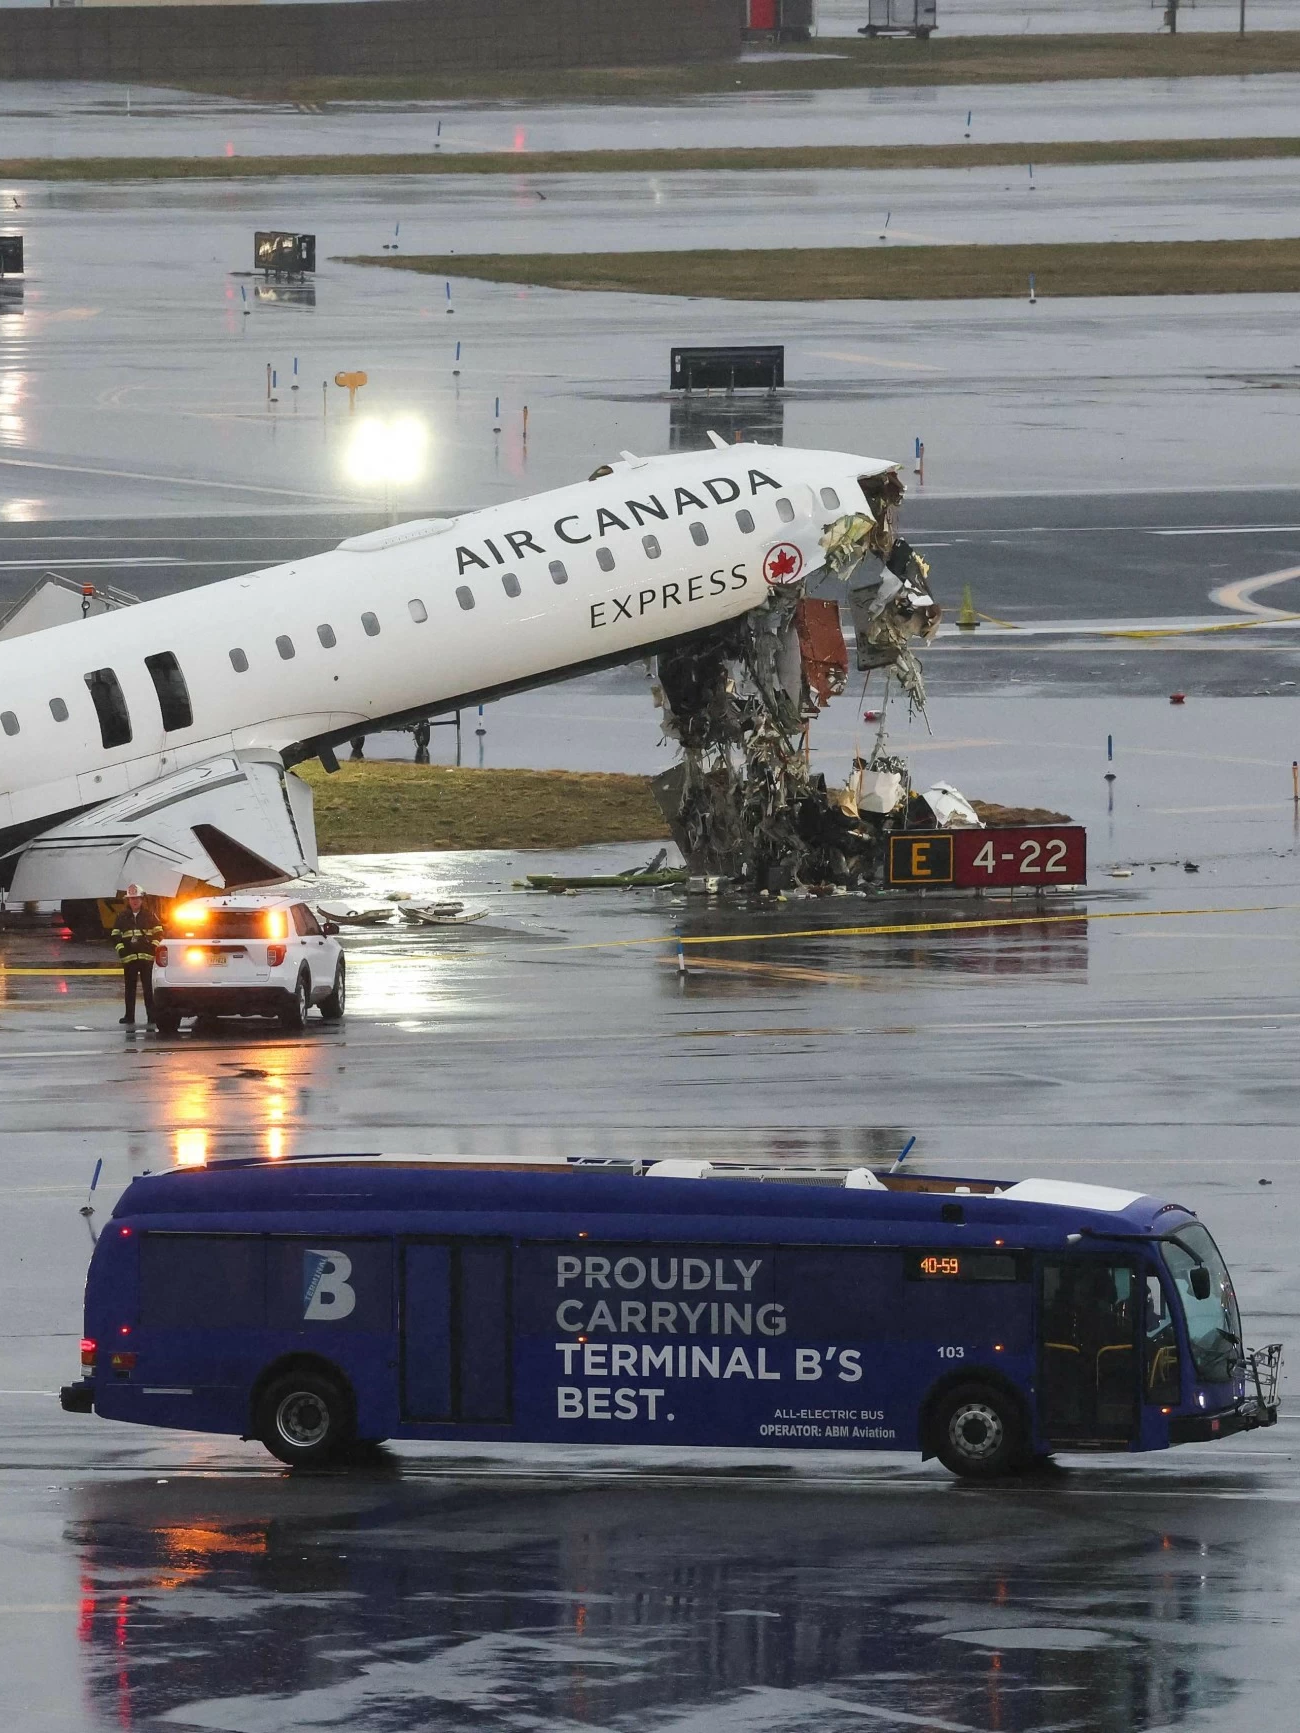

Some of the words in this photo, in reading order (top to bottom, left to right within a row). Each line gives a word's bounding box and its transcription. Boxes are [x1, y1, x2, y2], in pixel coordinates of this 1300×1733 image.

[455, 530, 547, 575] AIR
[553, 469, 784, 545] CANADA
[590, 563, 748, 629] EXPRESS
[911, 842, 932, 876] E
[972, 839, 1067, 874] 4-22
[556, 1255, 763, 1292] PROUDLY
[920, 1257, 959, 1274] 40-59
[303, 1249, 356, 1320] B
[555, 1299, 788, 1337] CARRYING
[555, 1342, 781, 1380] TERMINAL
[795, 1346, 864, 1382] B'S
[936, 1346, 965, 1359] 103
[556, 1386, 675, 1422] BEST.
[774, 1408, 858, 1420] ALL-ELECTRIC
[860, 1409, 885, 1421] BUS
[759, 1424, 822, 1438] OPERATOR:
[824, 1425, 849, 1438] ABM
[852, 1426, 896, 1439] Aviation
